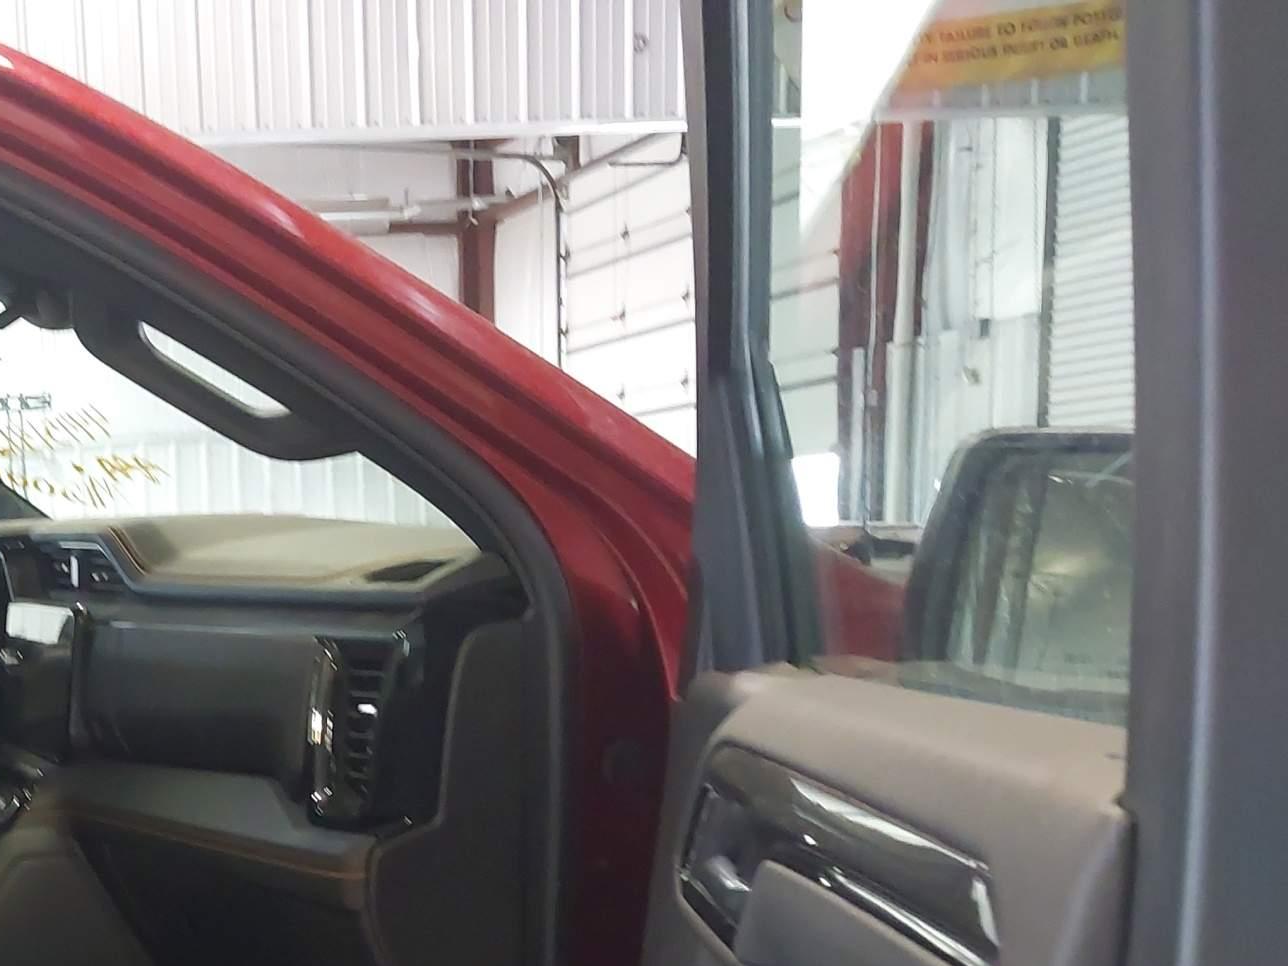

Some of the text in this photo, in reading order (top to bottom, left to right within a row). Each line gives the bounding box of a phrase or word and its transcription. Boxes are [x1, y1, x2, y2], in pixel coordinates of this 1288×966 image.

[998, 21, 1016, 36] TO
[943, 45, 998, 63] SERIOUS
[1049, 35, 1068, 50] OR
